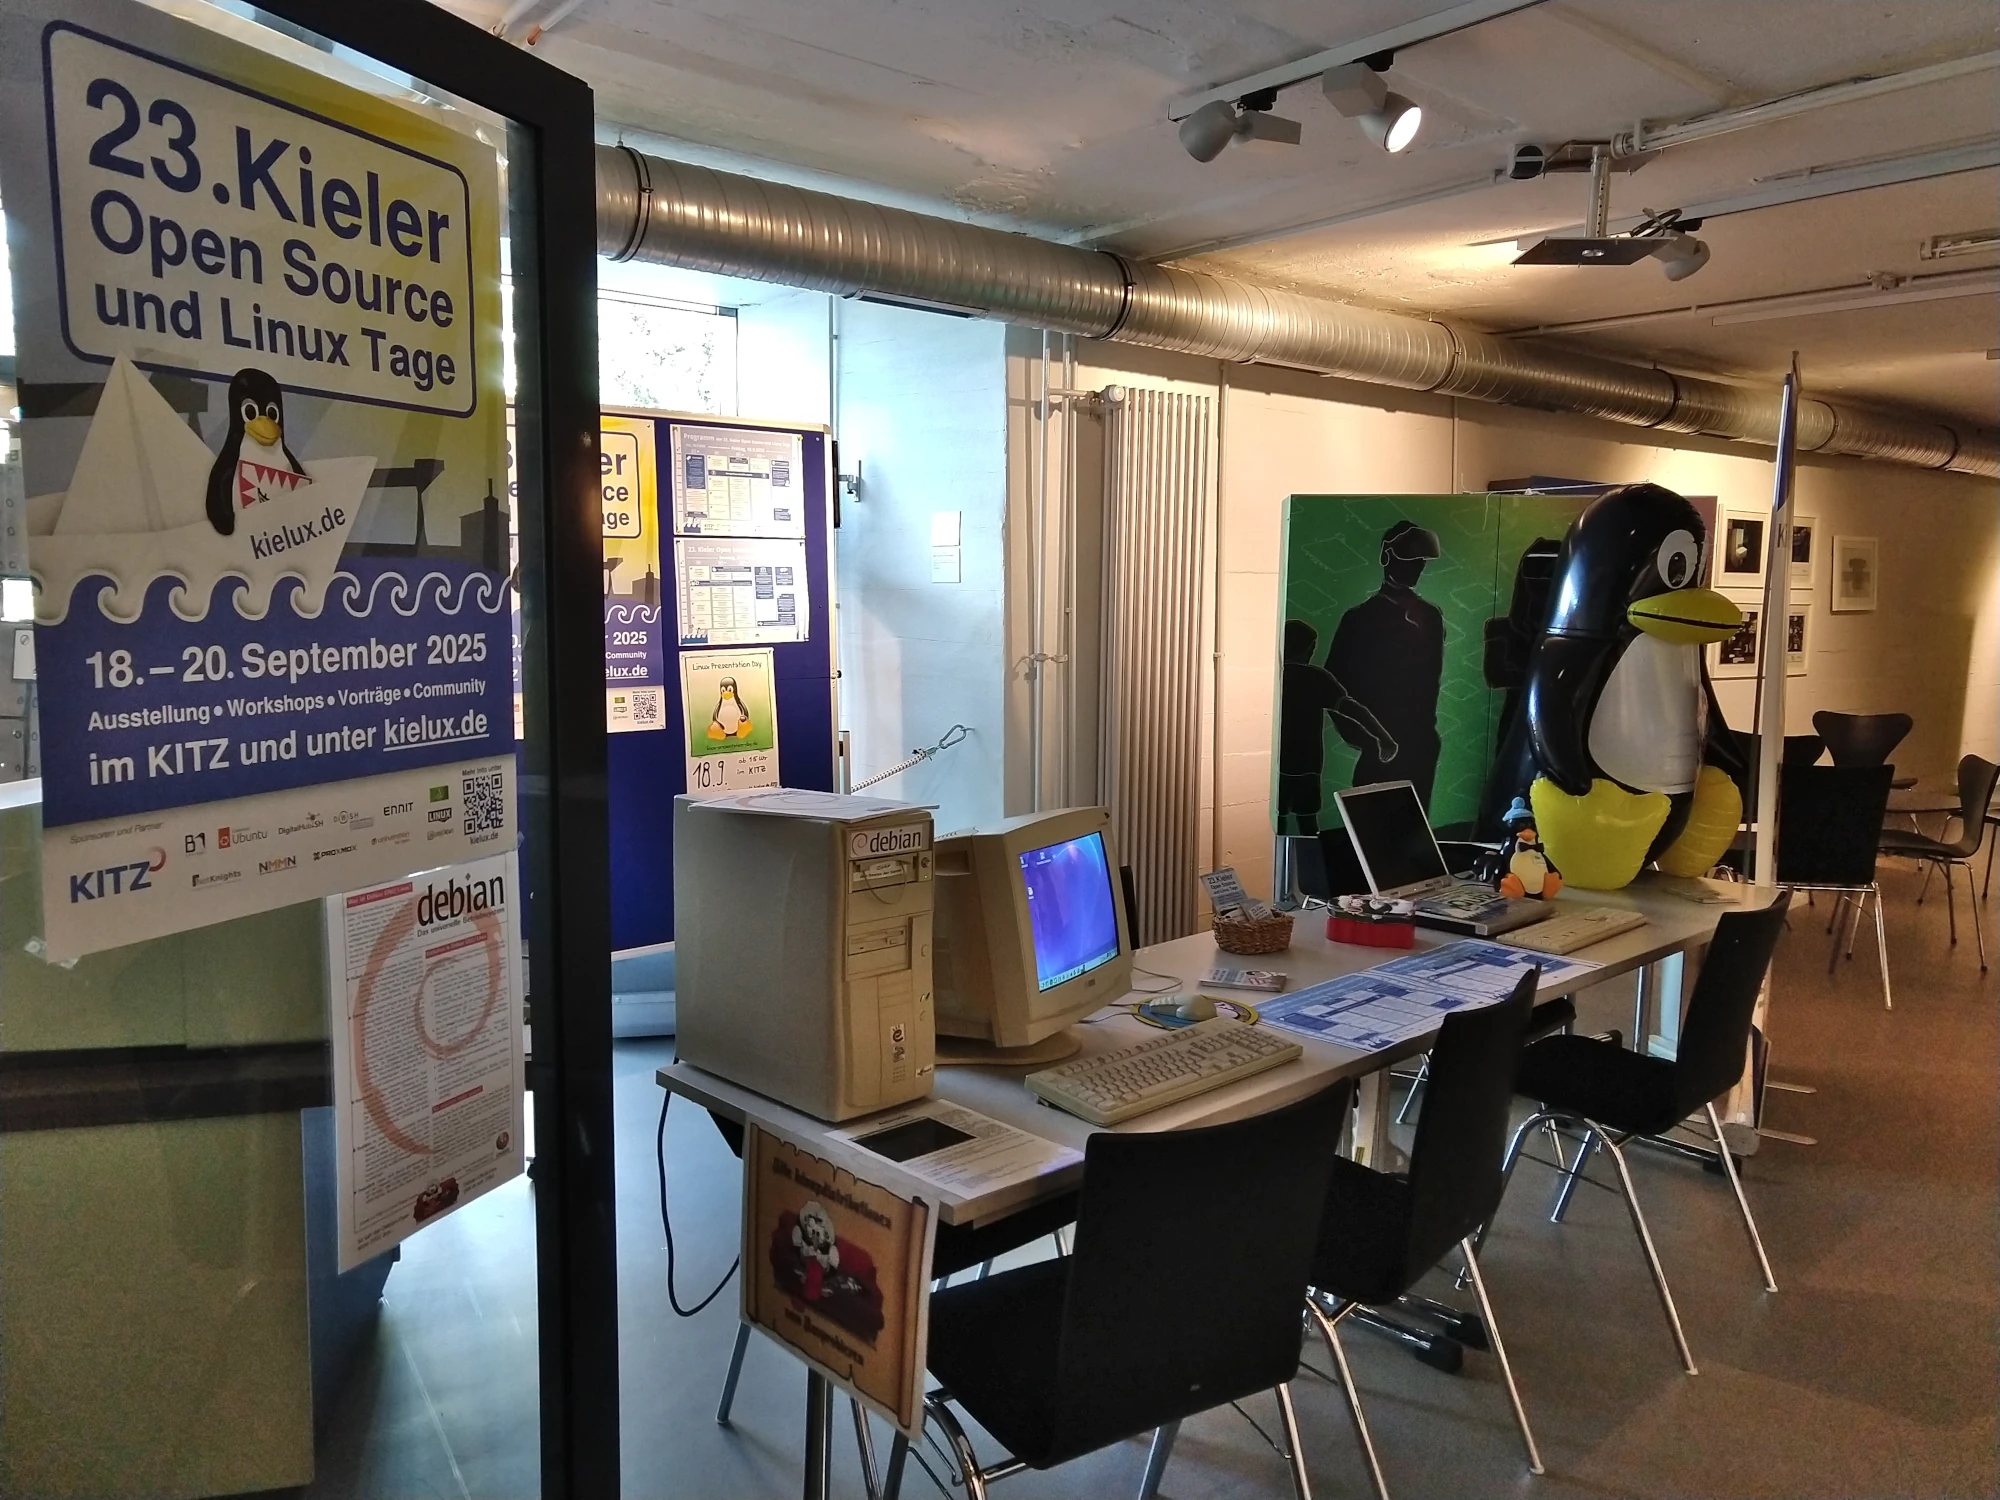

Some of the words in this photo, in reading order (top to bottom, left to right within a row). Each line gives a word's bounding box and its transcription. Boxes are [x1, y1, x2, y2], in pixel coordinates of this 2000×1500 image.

[90, 189, 263, 284] Open
[283, 239, 454, 328] Source
[95, 283, 202, 340] und
[220, 297, 350, 367] Linux
[361, 328, 456, 391] Tage
[250, 504, 347, 560] kielux.de
[613, 631, 648, 645] 2025
[241, 637, 417, 684] September
[426, 633, 487, 666] 2025
[605, 651, 647, 660] Community
[605, 665, 648, 677] elux.de
[88, 703, 210, 731] Ausstellung
[226, 690, 324, 718] Workshops
[338, 685, 401, 708] Vorträge
[412, 678, 486, 701] Community
[89, 752, 134, 786] im
[148, 738, 230, 778] KITZ
[239, 731, 298, 768] und
[306, 722, 377, 757] unter
[383, 709, 489, 748] kielux.de
[429, 809, 451, 822] LINUX
[232, 829, 267, 845] Ubuntu
[470, 832, 499, 845] kielux.de
[870, 829, 921, 853] debian
[259, 855, 297, 874] NMMN
[70, 861, 152, 904] KITZ
[417, 873, 505, 927] debian
[417, 929, 429, 938] Das
